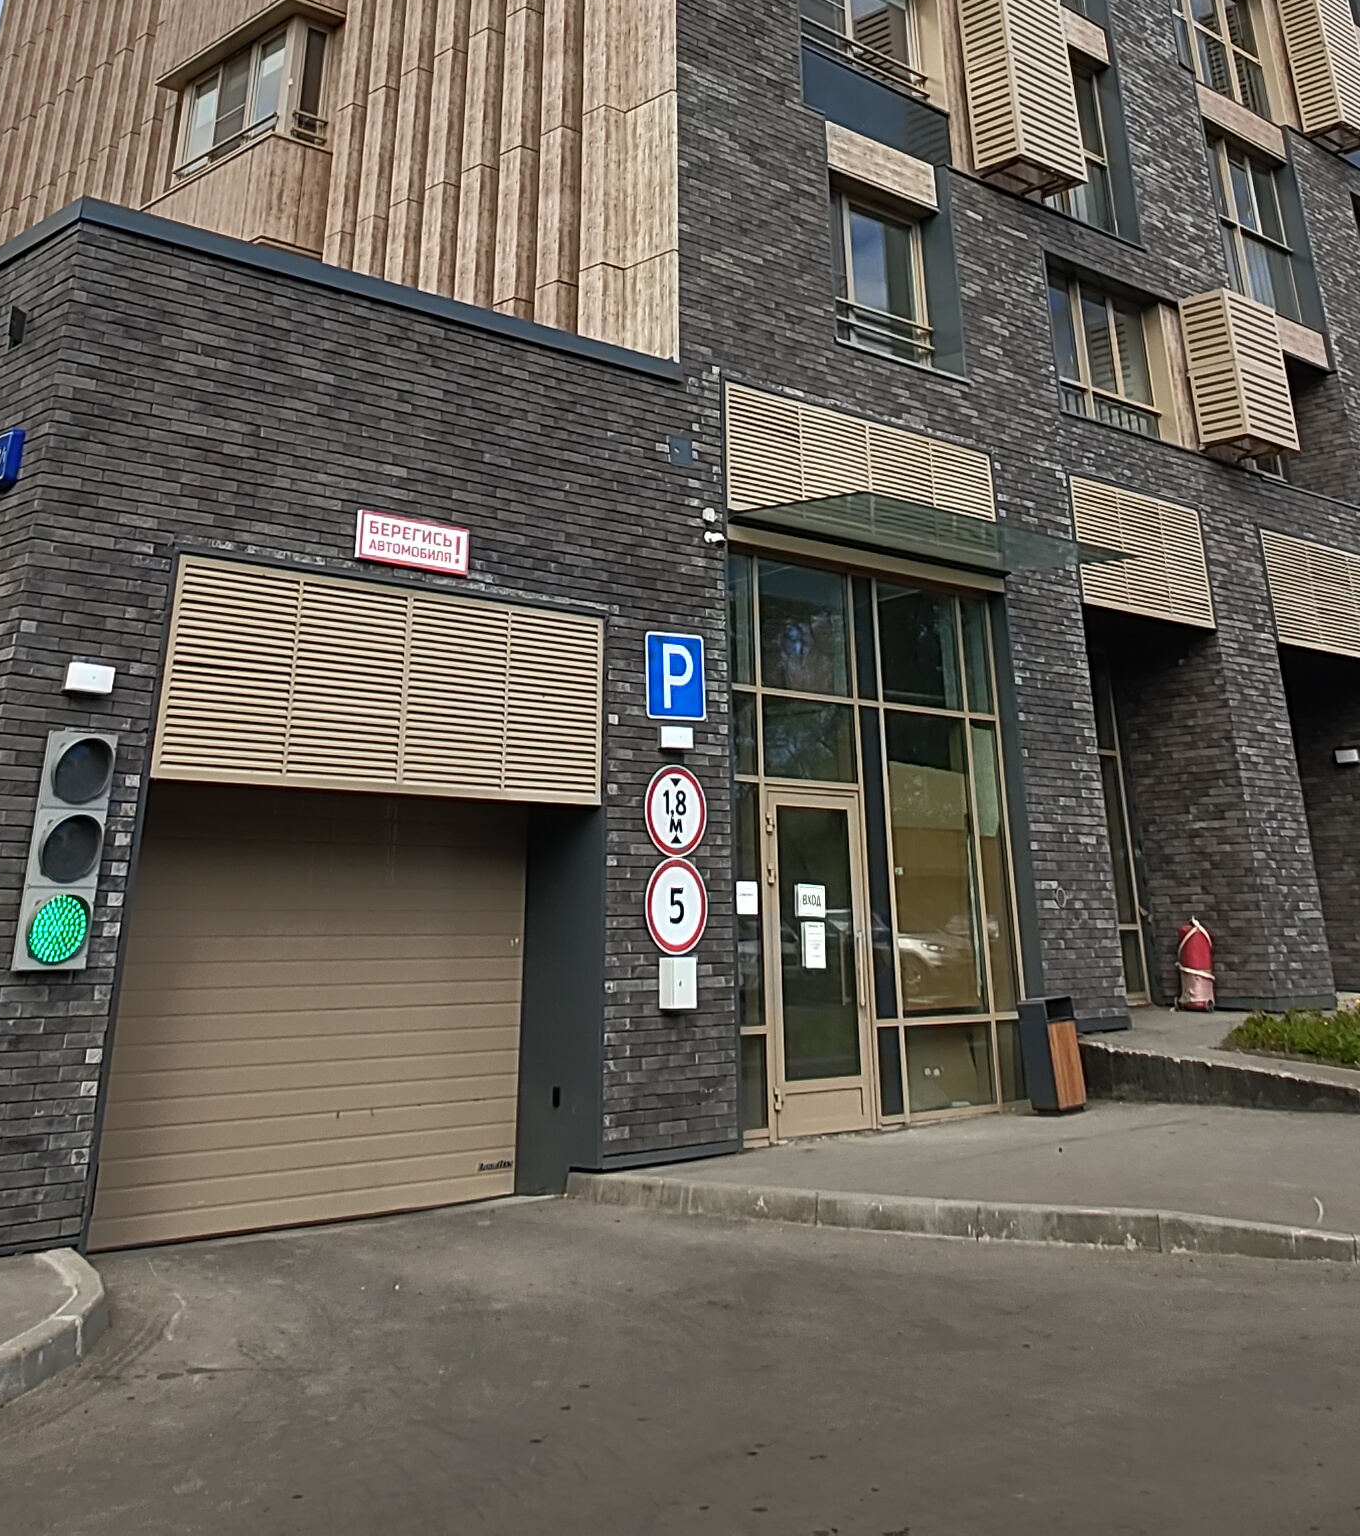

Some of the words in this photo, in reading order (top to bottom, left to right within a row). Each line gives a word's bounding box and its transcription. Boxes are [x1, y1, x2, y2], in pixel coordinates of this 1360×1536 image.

[369, 520, 453, 547] БЕРЕГИСЬ
[662, 642, 694, 709] P
[669, 886, 685, 925] 5
[802, 893, 822, 908] ВХОД
